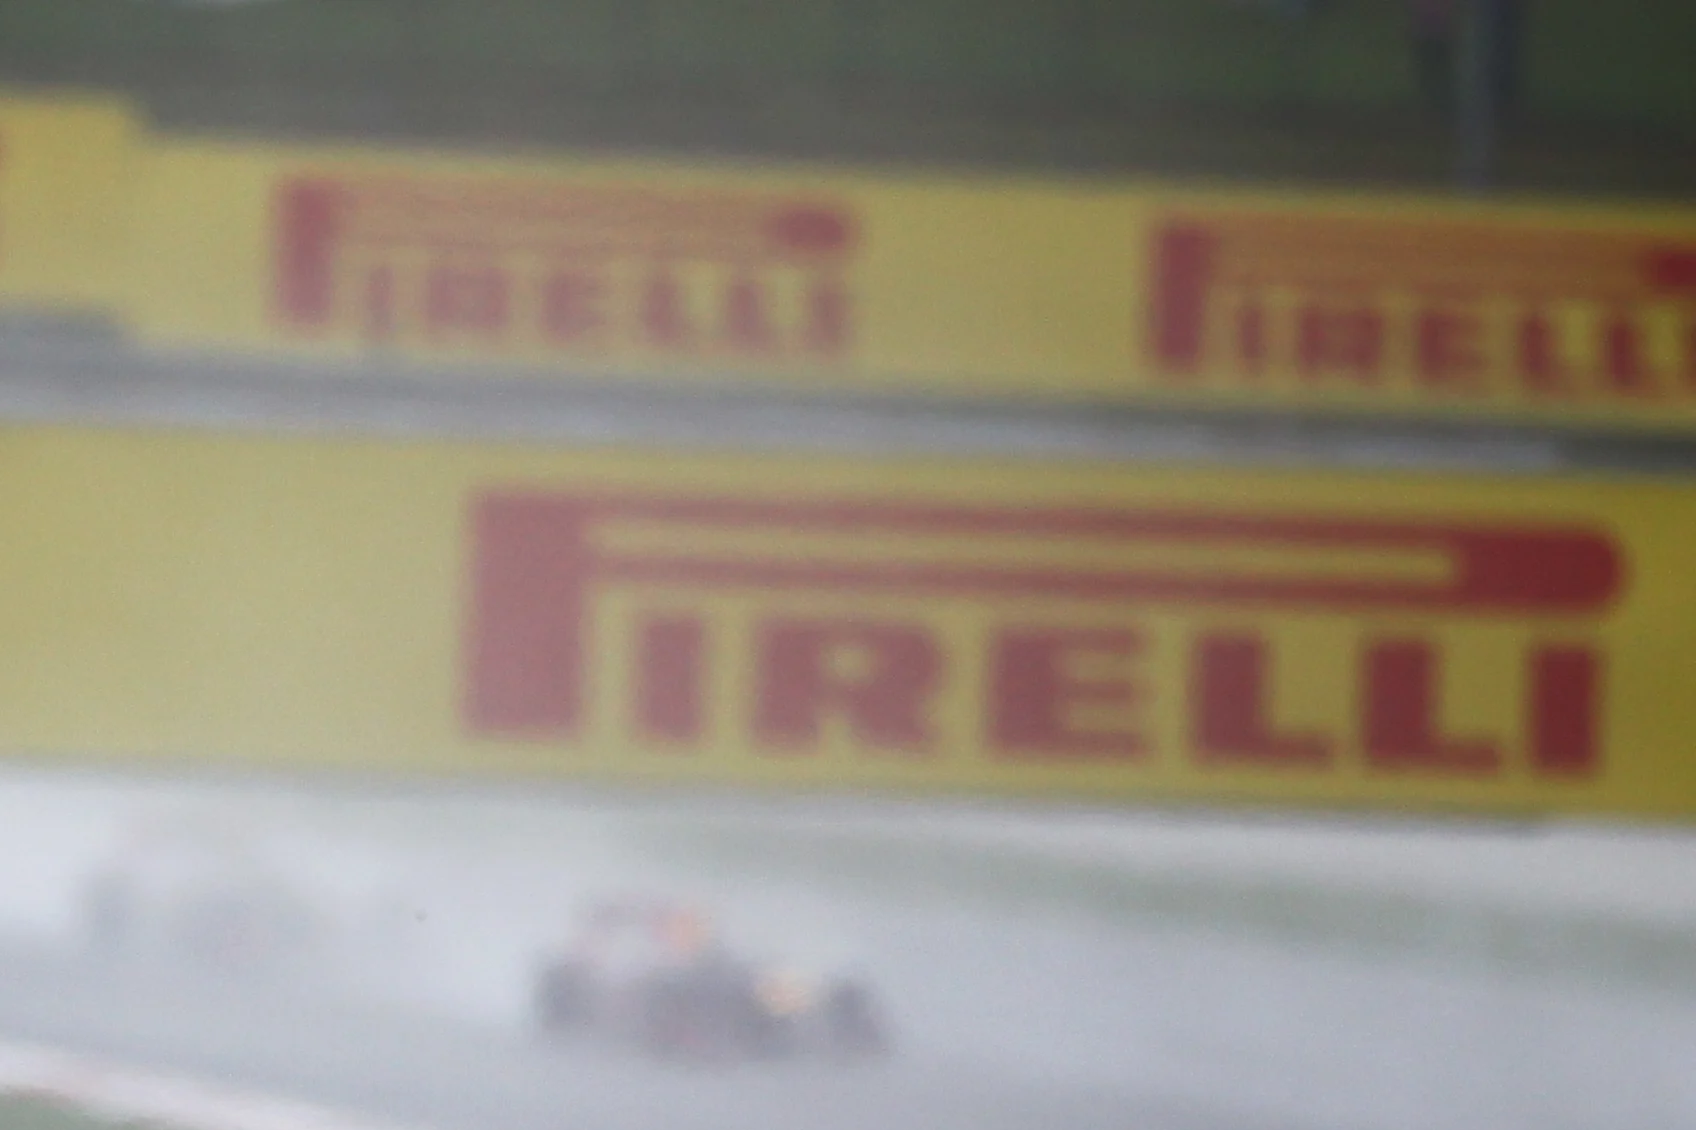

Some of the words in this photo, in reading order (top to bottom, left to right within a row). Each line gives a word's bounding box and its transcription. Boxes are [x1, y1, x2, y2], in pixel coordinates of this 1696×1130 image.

[270, 170, 857, 355] PIRELLI
[1148, 208, 1696, 403] PIRELL
[460, 487, 1628, 783] PIRELLI
